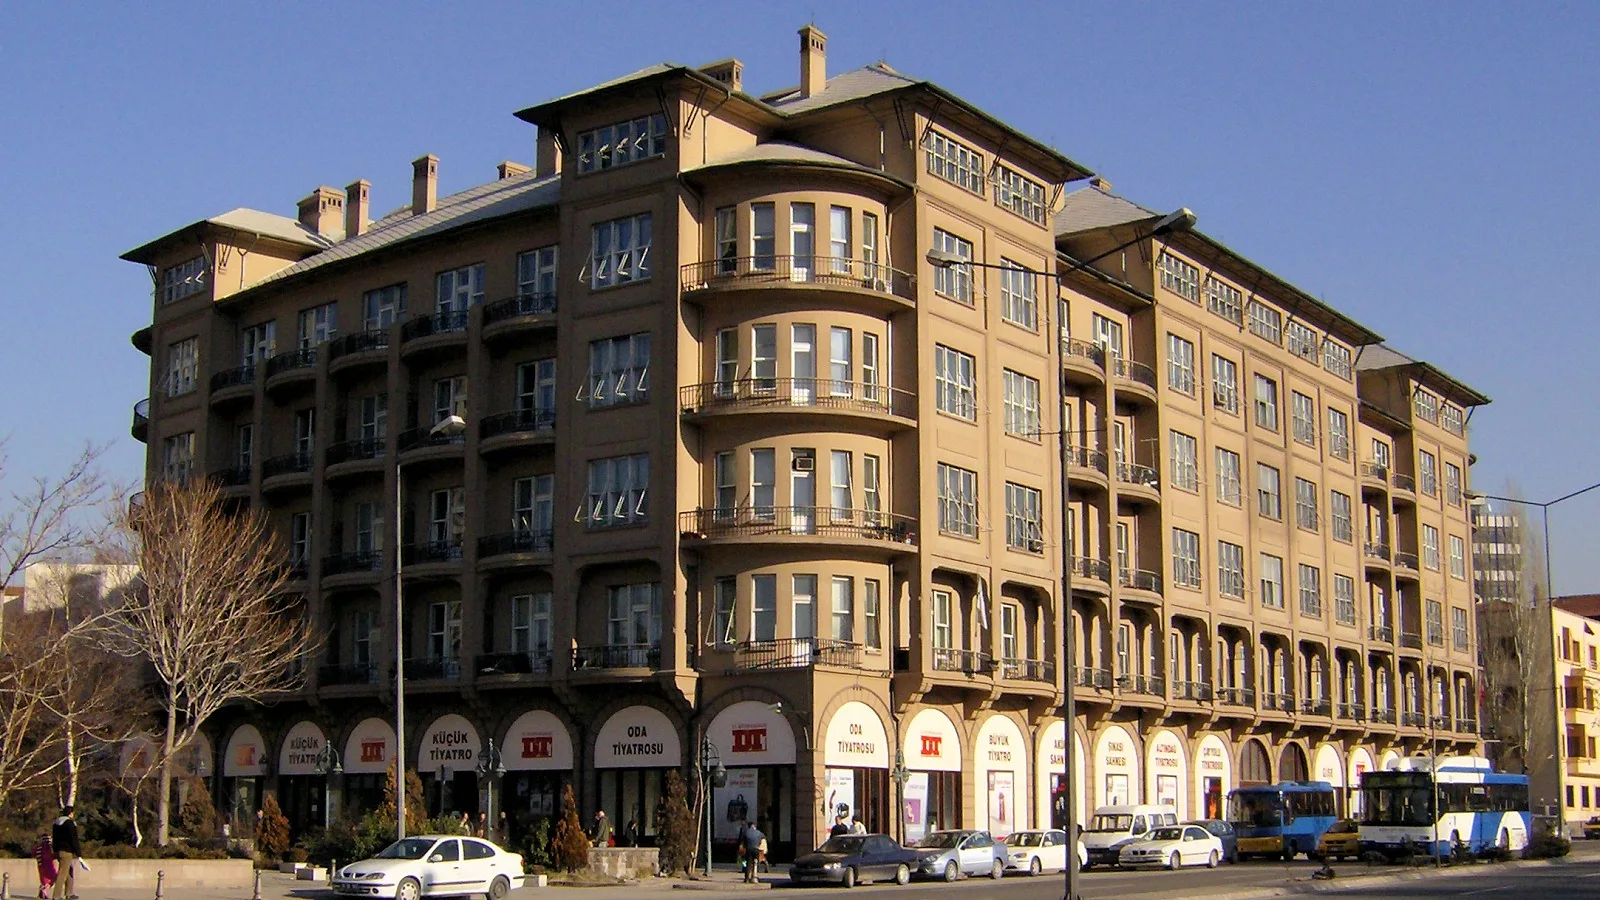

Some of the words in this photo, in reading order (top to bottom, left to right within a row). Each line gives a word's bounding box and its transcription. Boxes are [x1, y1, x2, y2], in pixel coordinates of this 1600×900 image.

[627, 726, 647, 737] ODA
[849, 723, 862, 735] ODA
[290, 737, 319, 751] KÜÇÜK
[432, 731, 468, 746] KÜÇÜK
[989, 733, 1009, 746] BÜYÜK
[613, 742, 663, 755] TİYATROSU
[838, 739, 875, 754] TİYATROSU
[289, 752, 320, 765] TİYATR
[430, 748, 472, 761] TİYATRO
[988, 750, 1011, 762] TİYATRO
